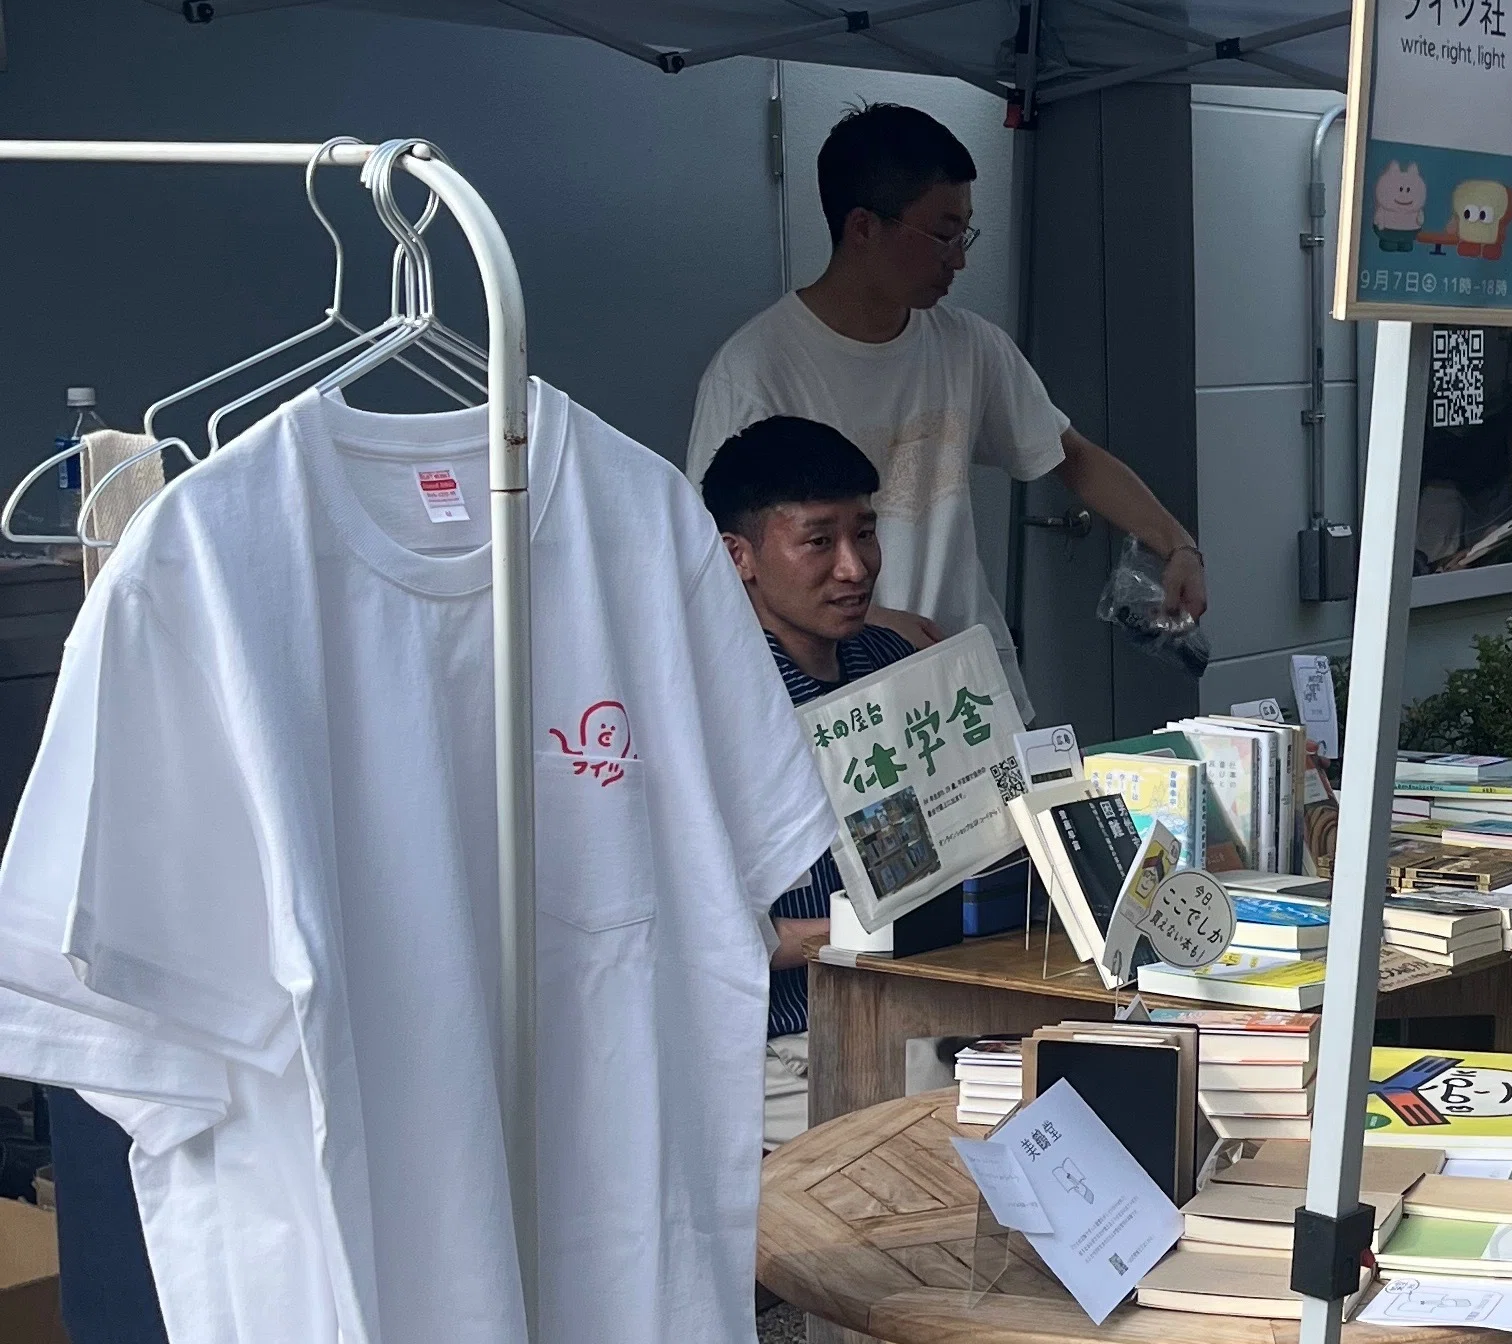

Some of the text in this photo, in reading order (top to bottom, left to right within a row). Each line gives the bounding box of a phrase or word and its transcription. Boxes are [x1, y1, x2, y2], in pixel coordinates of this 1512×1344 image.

[843, 686, 993, 793] 休学舎
[1163, 888, 1223, 943] ここでしか
